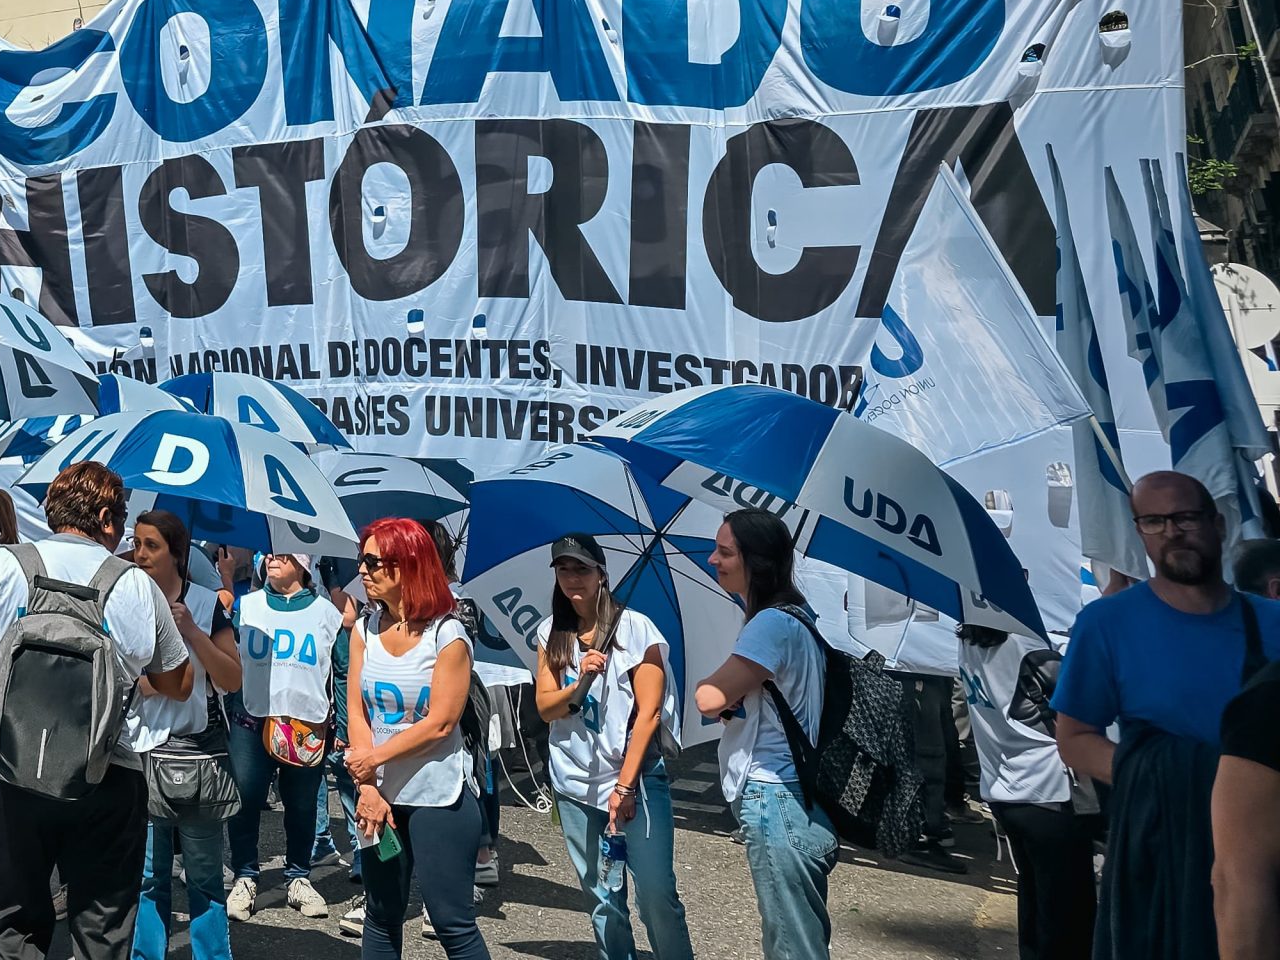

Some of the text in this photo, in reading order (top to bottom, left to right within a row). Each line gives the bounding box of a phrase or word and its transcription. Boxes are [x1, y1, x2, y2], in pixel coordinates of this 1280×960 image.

[169, 343, 320, 381] NACIONAL
[365, 338, 563, 389] DOCENTES,
[143, 433, 211, 486] D
[843, 476, 944, 557] UDA
[247, 628, 318, 668] UDA
